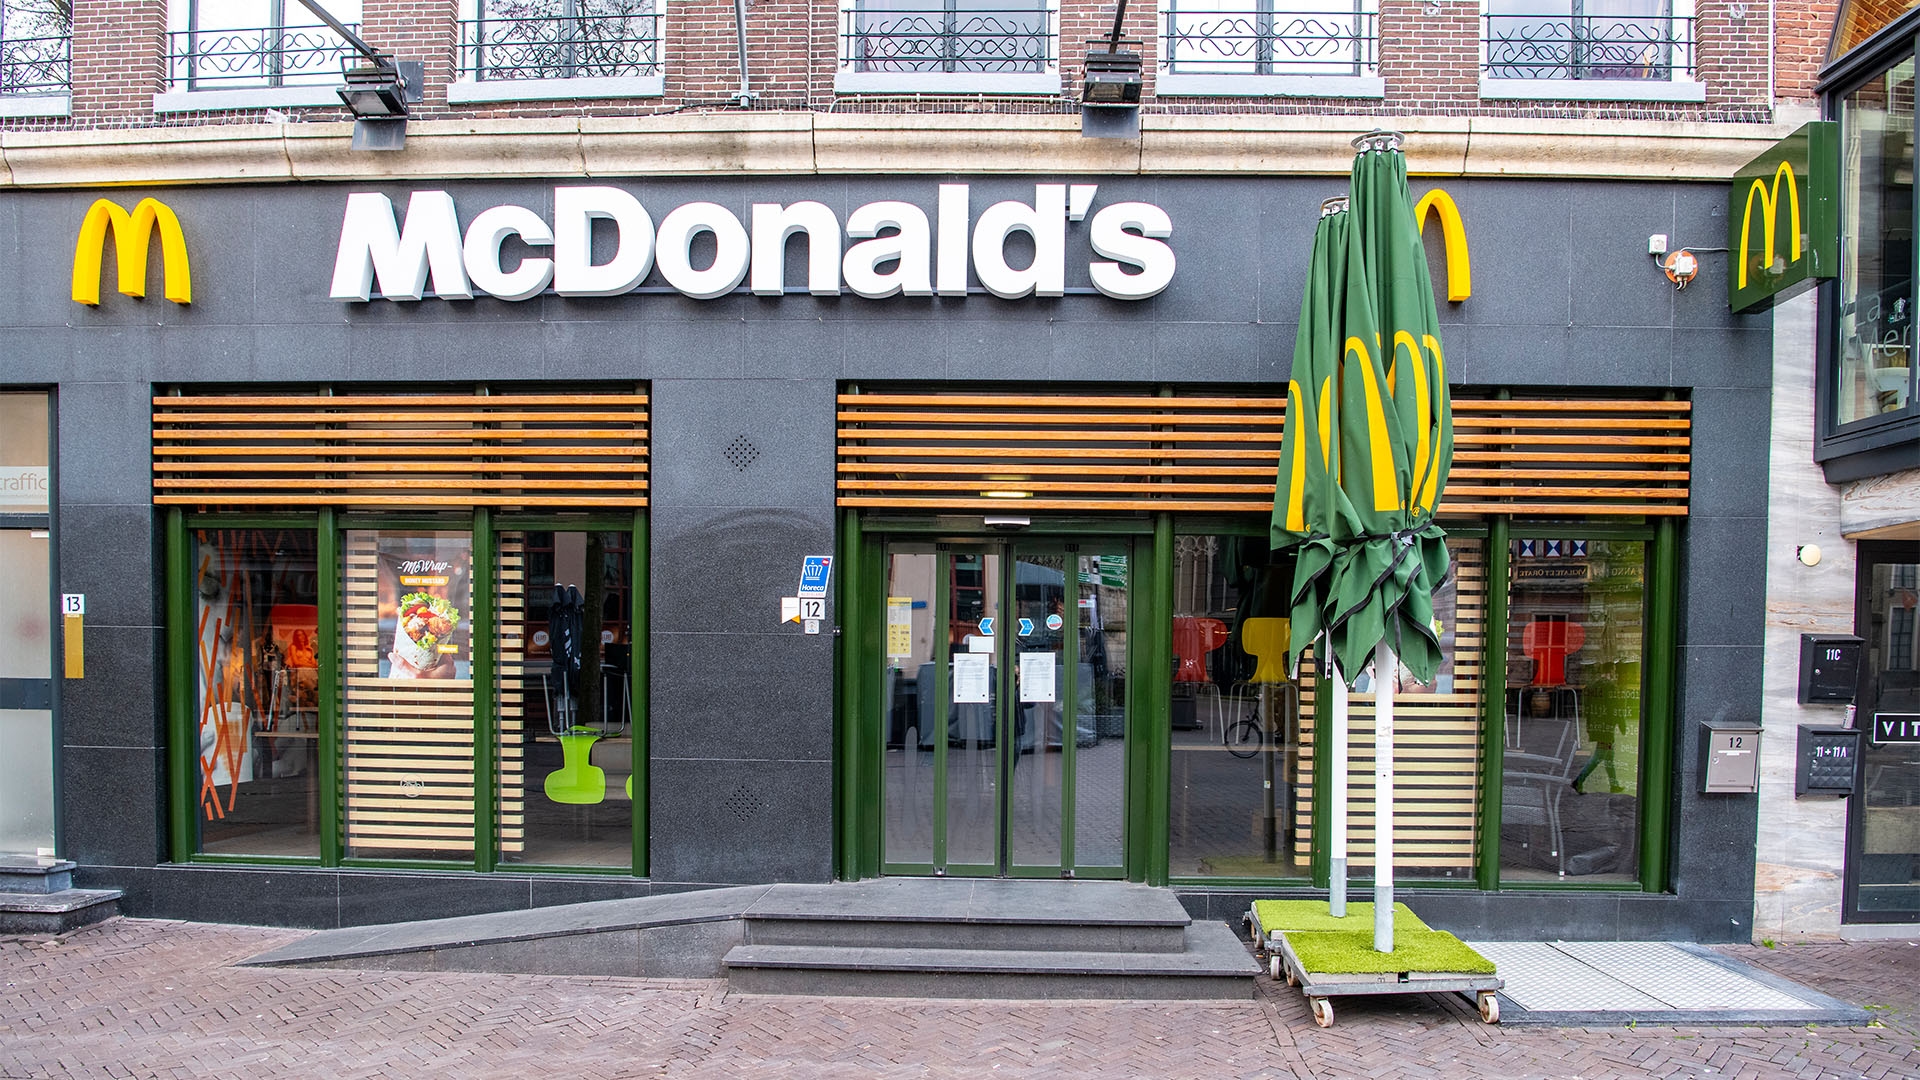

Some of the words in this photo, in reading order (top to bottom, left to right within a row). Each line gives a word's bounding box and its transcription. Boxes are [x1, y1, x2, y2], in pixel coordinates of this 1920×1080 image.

[329, 184, 1177, 302] McDonald's
[66, 596, 81, 612] 13
[805, 601, 821, 617] 12
[1826, 648, 1841, 661] 11C
[1882, 721, 1920, 737] VIT
[1729, 736, 1743, 748] 12
[1816, 746, 1824, 757] 11
[1833, 746, 1847, 757] 11A
